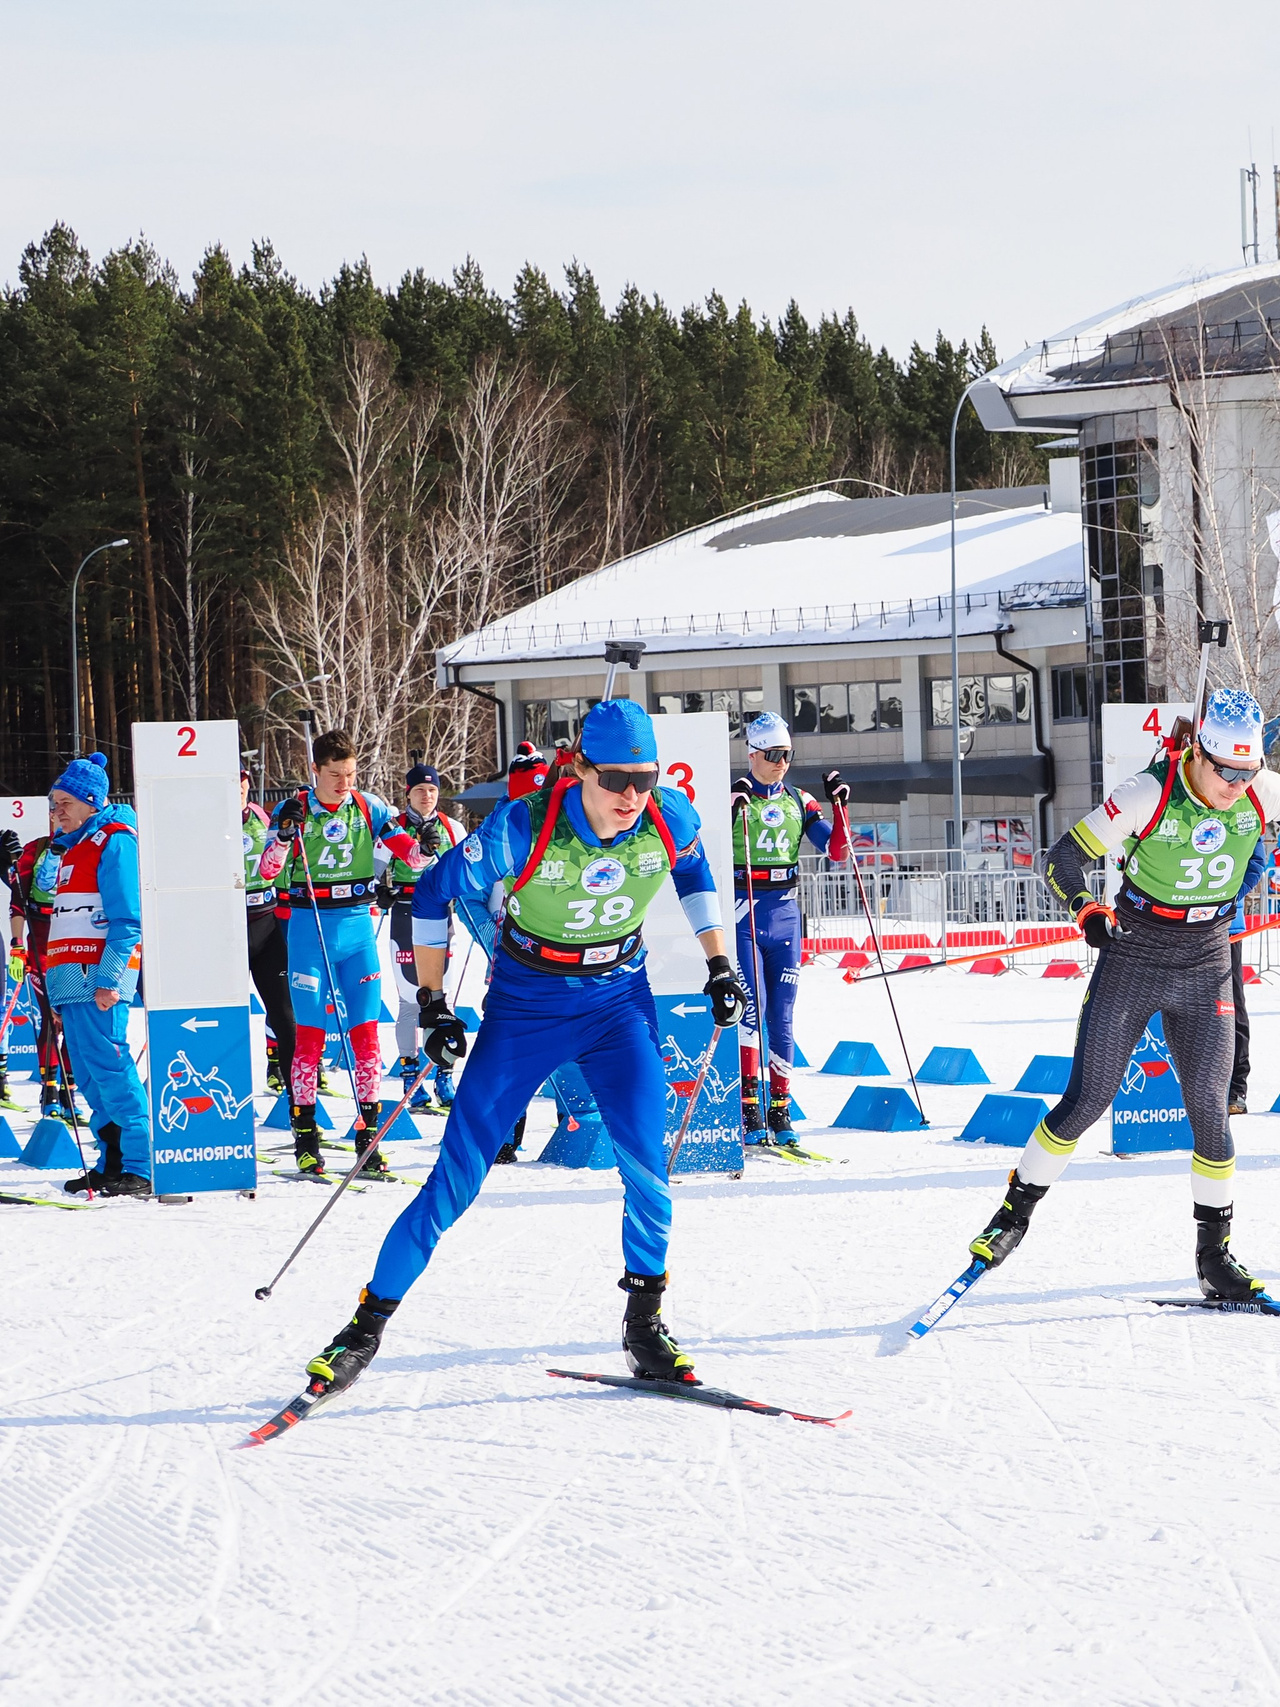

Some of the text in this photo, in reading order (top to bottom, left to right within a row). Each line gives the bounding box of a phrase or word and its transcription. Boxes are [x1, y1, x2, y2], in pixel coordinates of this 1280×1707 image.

[1142, 708, 1162, 737] 4
[176, 726, 198, 758] 2
[1200, 731, 1220, 750] OAX
[665, 761, 696, 805] 3
[12, 800, 25, 818] 3
[756, 829, 791, 853] 44
[317, 843, 354, 869] 43
[1174, 853, 1236, 890] 39
[1172, 890, 1228, 902] КРАСНОЯРСК
[563, 895, 635, 930] 38
[71, 943, 98, 954] край
[1114, 1107, 1187, 1125] КРАСНОЯР
[663, 1126, 741, 1146] АСНОЯРСК
[154, 1144, 254, 1165] КРАСНОЯРСК
[629, 1277, 645, 1287] 188
[1222, 1302, 1261, 1313] SALOMON
